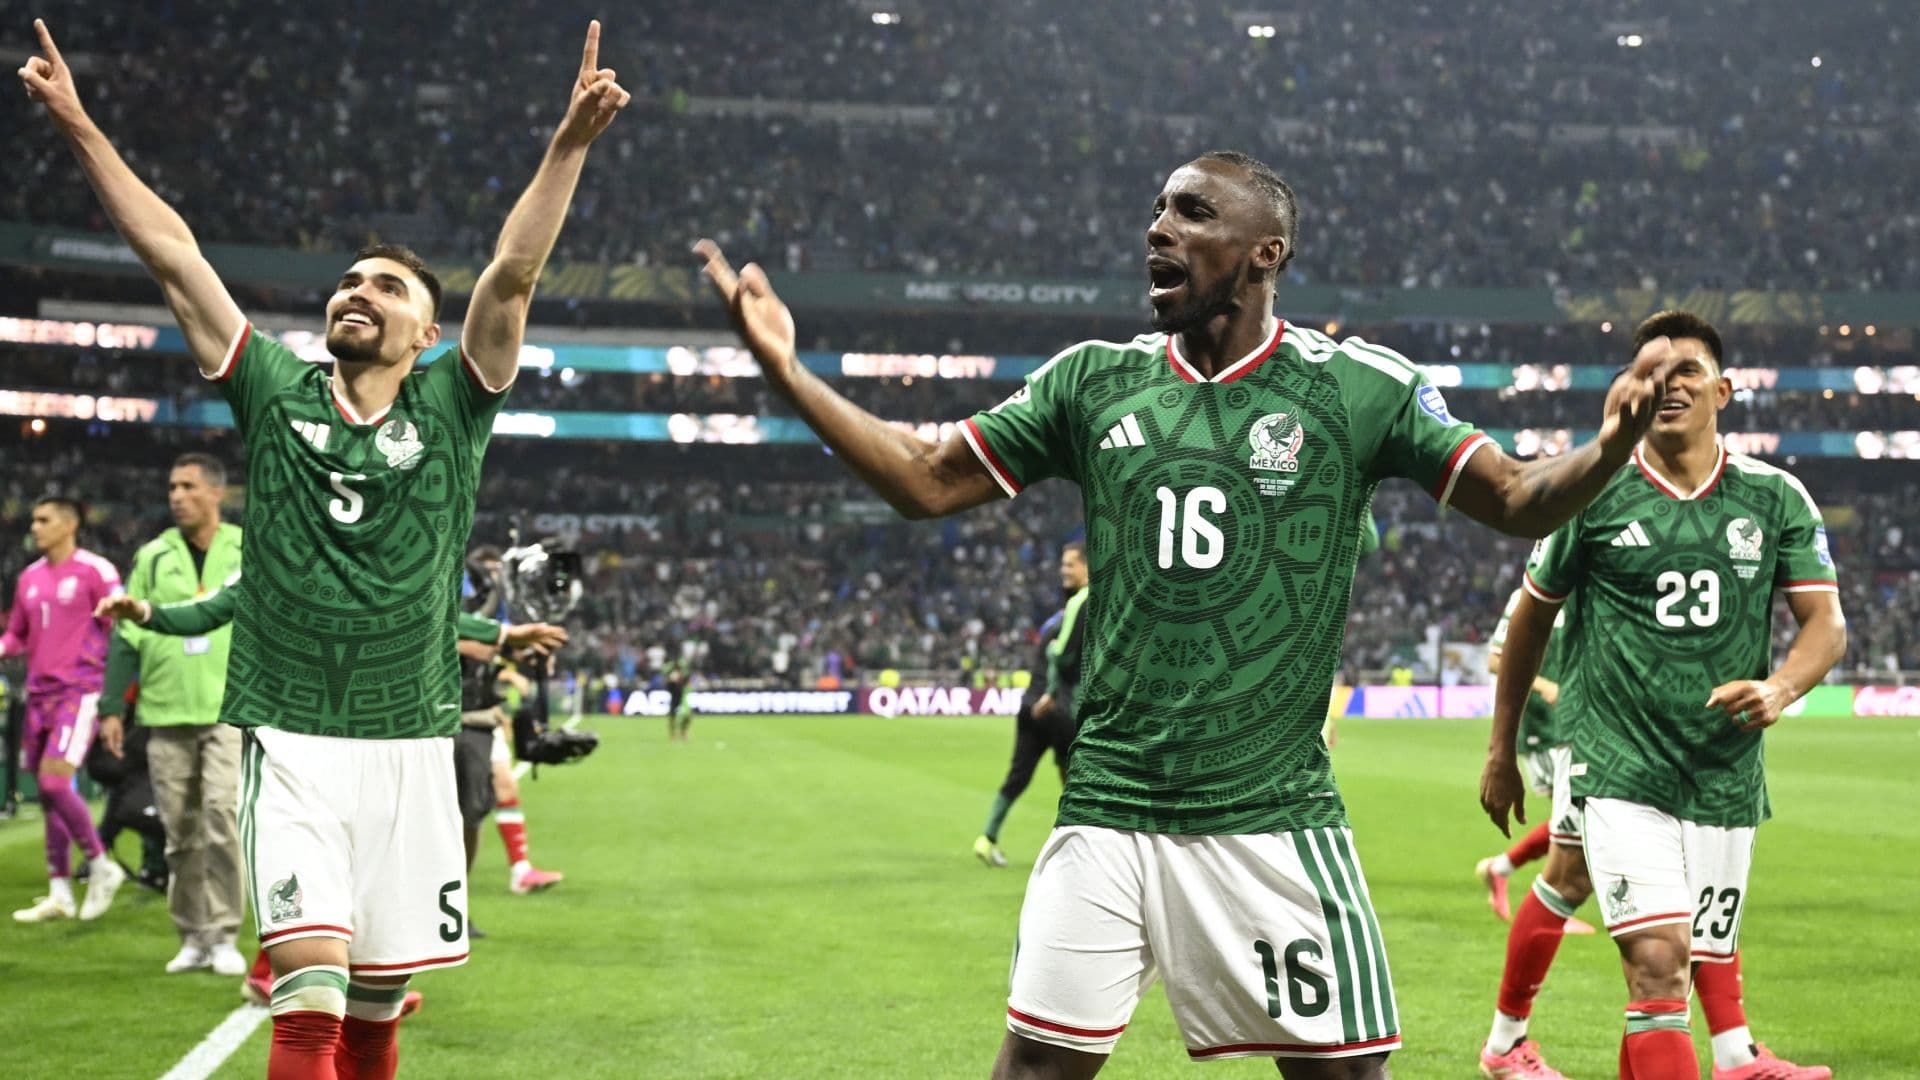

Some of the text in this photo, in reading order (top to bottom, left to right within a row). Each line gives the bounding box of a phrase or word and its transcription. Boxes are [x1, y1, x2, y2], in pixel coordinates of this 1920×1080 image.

[1028, 284, 1099, 303] CITY
[1250, 458, 1298, 471] MEXICO
[329, 471, 366, 523] 5
[1156, 486, 1226, 569] 16
[40, 602, 49, 628] 1
[1655, 569, 1720, 628] 23
[868, 687, 973, 719] QATAR
[58, 725, 72, 752] 1
[438, 880, 463, 943] 5
[1692, 886, 1740, 940] 23
[1253, 938, 1330, 1019] 16
